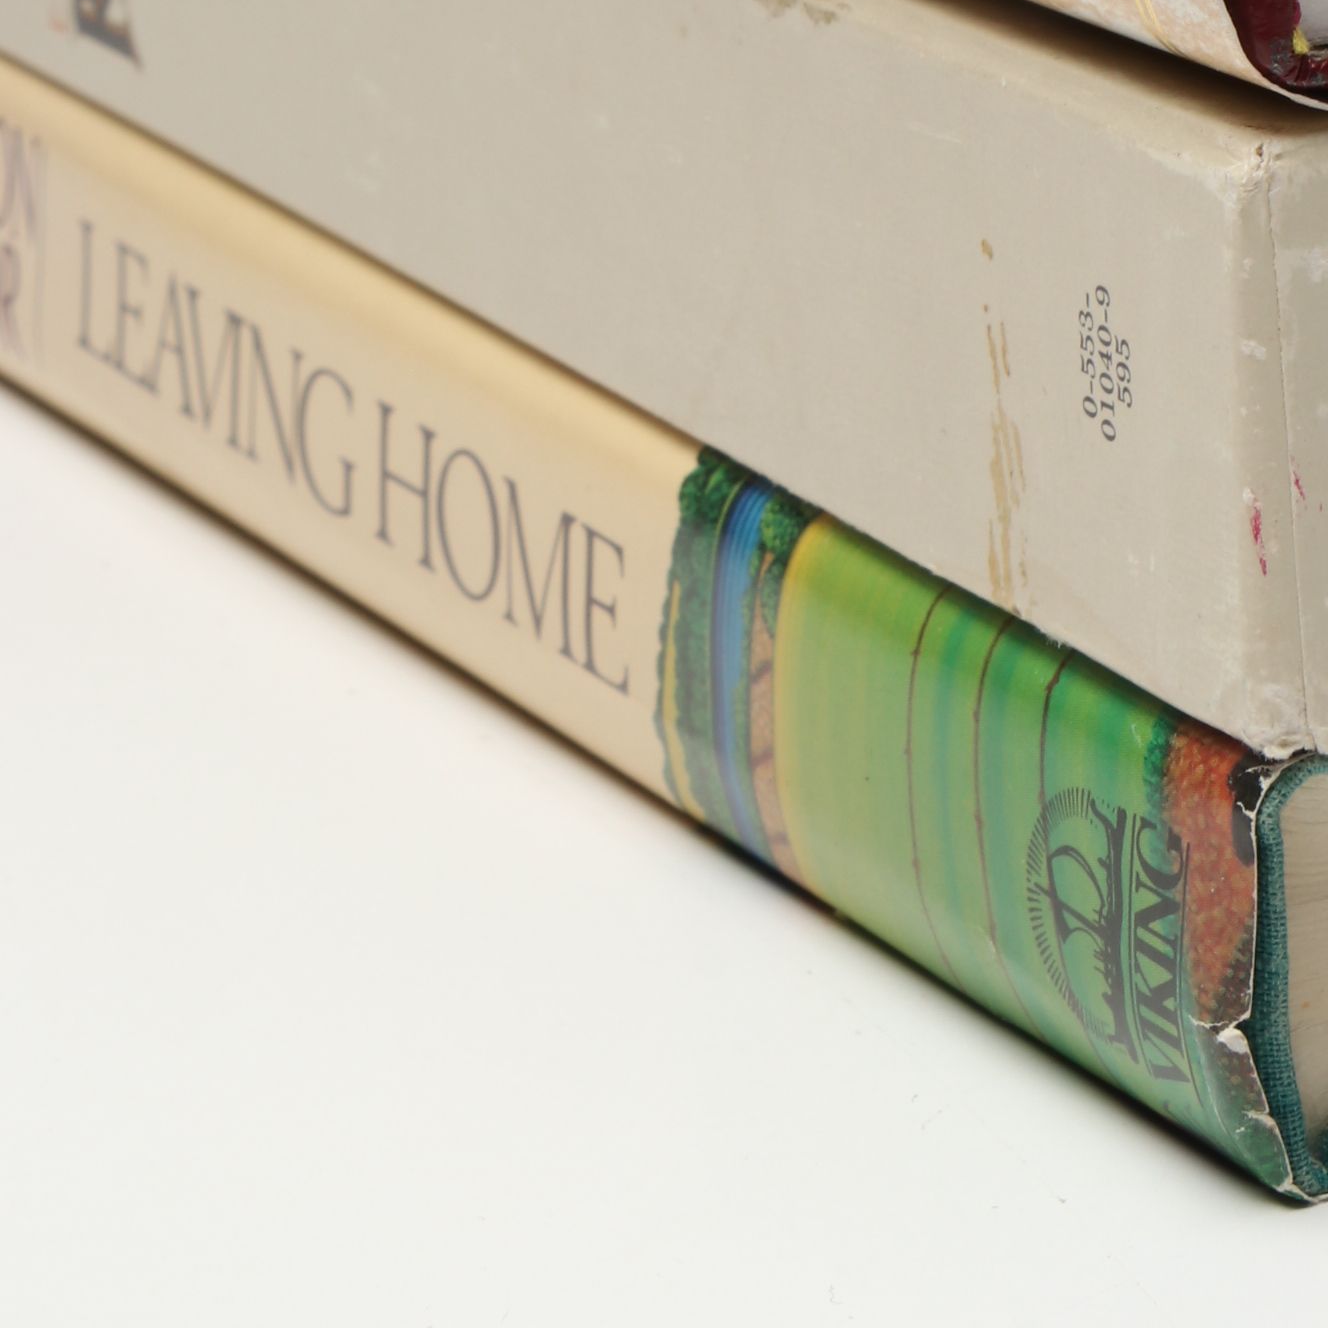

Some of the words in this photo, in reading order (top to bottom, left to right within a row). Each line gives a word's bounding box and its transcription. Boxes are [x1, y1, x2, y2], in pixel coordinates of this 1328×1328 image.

[1078, 291, 1099, 420] 0-553-
[1094, 284, 1117, 443] 01040-9
[1114, 334, 1133, 410] 595
[76, 217, 357, 519] LEAVING
[374, 398, 630, 698] HOME
[1134, 814, 1192, 1084] VIKING
